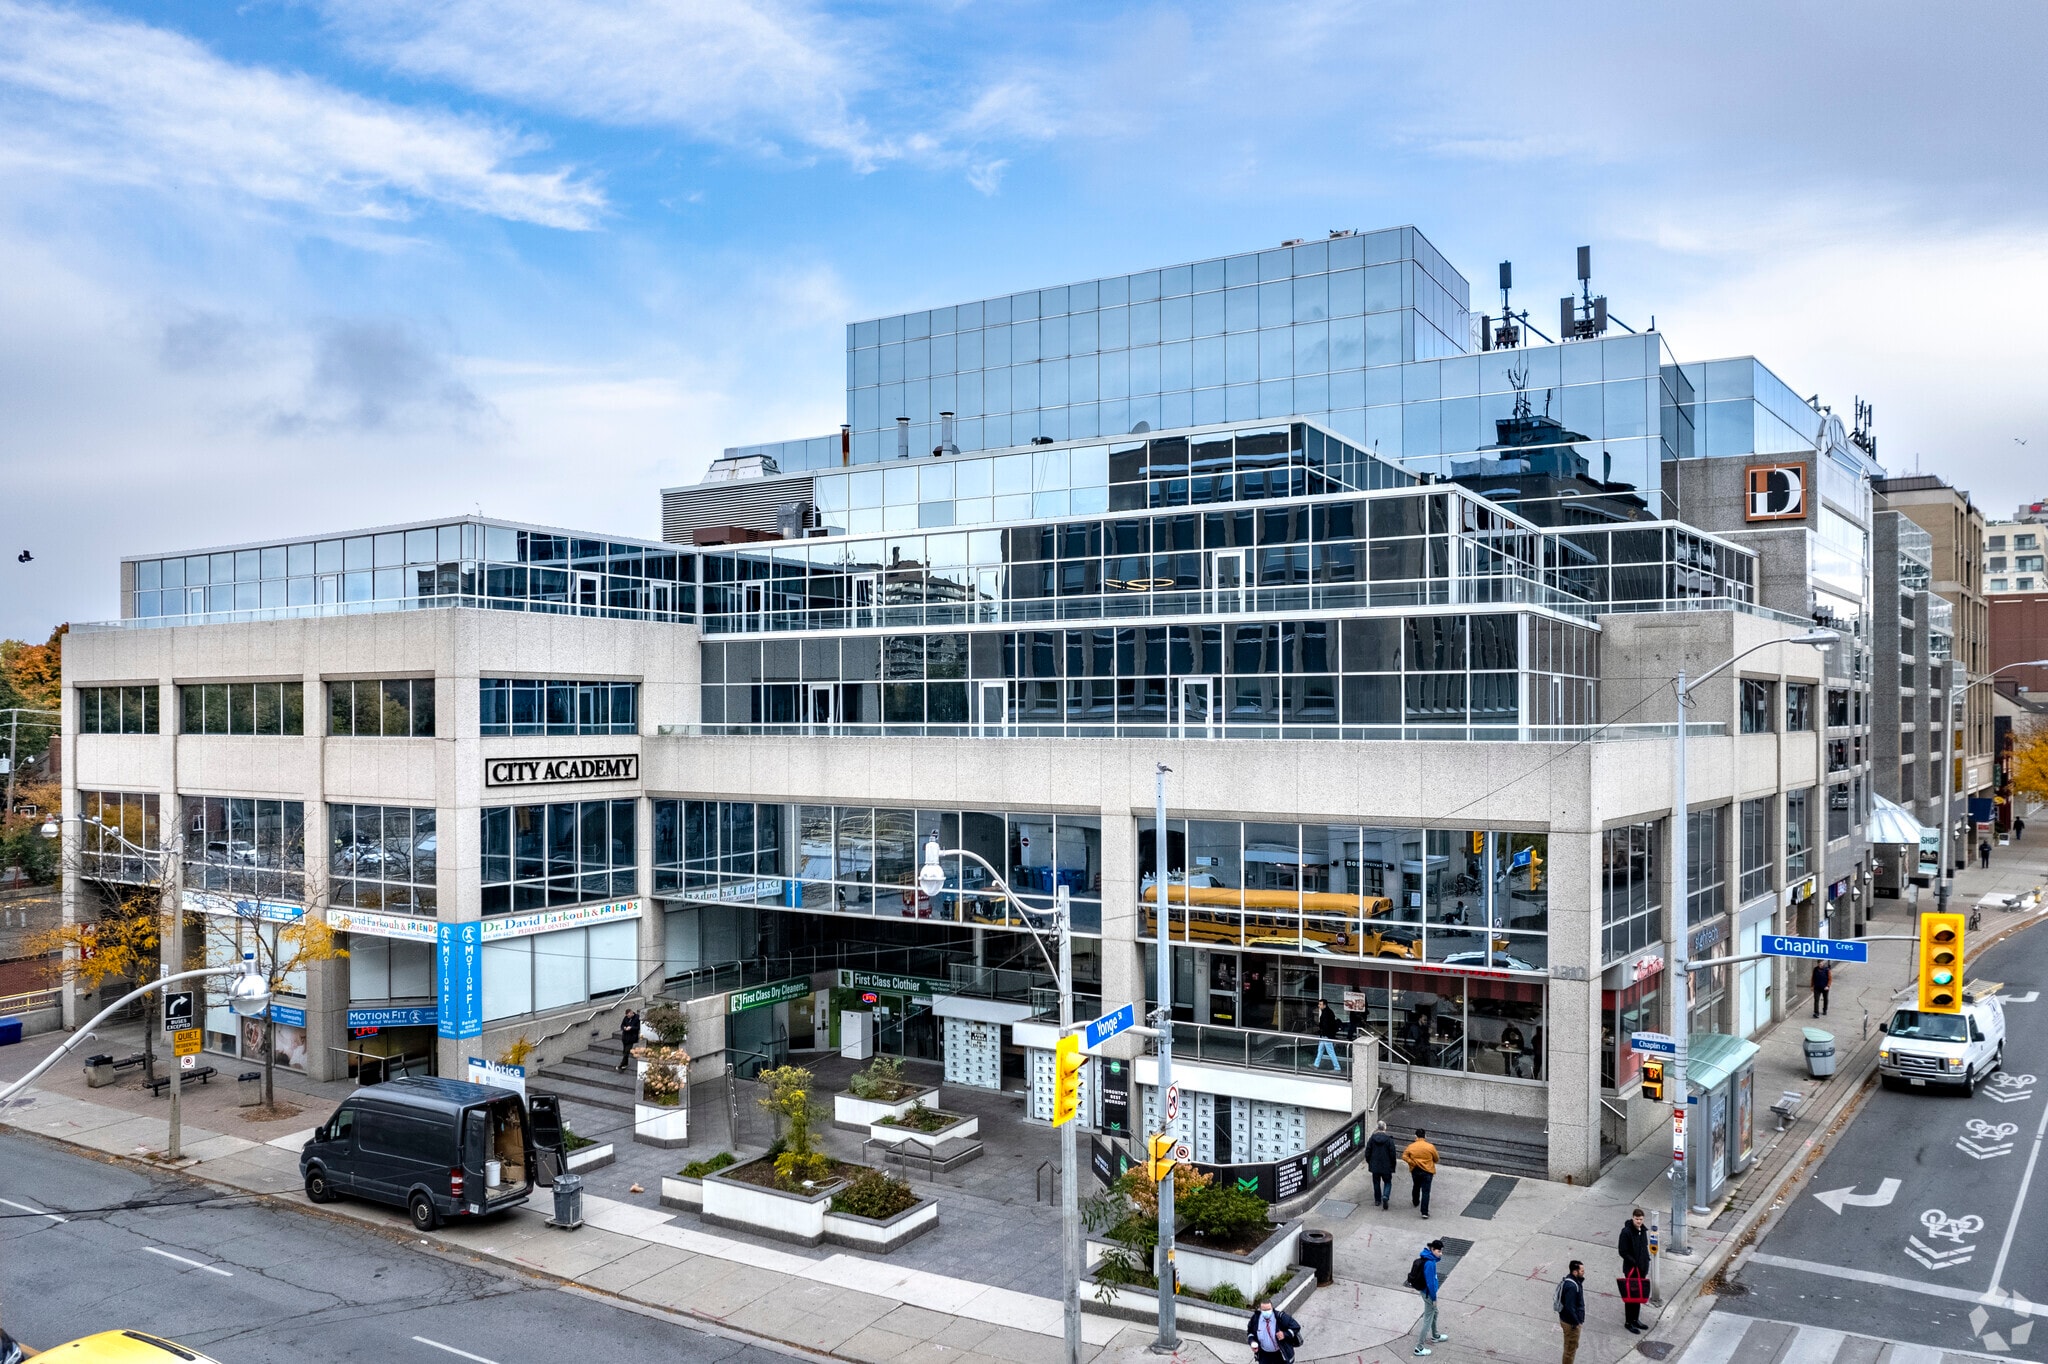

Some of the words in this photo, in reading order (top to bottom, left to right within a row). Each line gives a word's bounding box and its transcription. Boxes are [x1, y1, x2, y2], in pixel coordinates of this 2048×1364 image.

[493, 762, 540, 782] CITY
[543, 758, 633, 780] ACADEMY
[1920, 836, 1939, 845] SHOP
[482, 922, 503, 933] Dr.
[505, 915, 540, 929] David
[544, 908, 590, 924] Farkouh
[591, 909, 599, 917] &
[600, 902, 638, 915] FRIENDS
[367, 915, 399, 929] Farkouh
[400, 922, 407, 931] &
[407, 922, 437, 934] FRIENDS
[518, 923, 546, 935] PEDIATRIC
[548, 921, 571, 931] DENTIST
[1774, 937, 1829, 955] Chaplin
[1835, 942, 1854, 951] Cres
[464, 944, 474, 992] MOTION
[1551, 965, 1586, 980] 1310
[854, 973, 870, 986] First
[871, 975, 891, 988] Class
[892, 977, 920, 992] Clothier
[742, 993, 755, 1004] First
[755, 989, 771, 1001] Class
[771, 987, 781, 998] Dry
[781, 983, 804, 995] Cleaners
[349, 1011, 390, 1021] MOTION
[392, 1010, 407, 1019] FIT
[166, 1022, 191, 1030] EXCEPTED
[1096, 1016, 1118, 1038] Yonge
[177, 1030, 198, 1040] QUIET
[175, 1041, 199, 1049] RESIDENTIAL
[1638, 1040, 1661, 1050] Chaplin
[486, 1060, 520, 1077] Notice
[1103, 1088, 1128, 1096] TORONTO'S
[1105, 1098, 1127, 1106] WORKOUT
[1327, 1133, 1348, 1154] TORONTO'S
[1323, 1153, 1333, 1166] BEST
[1333, 1139, 1351, 1158] WORKOUT
[1279, 1162, 1297, 1171] PERSONAL
[1279, 1167, 1296, 1176] TRAINING
[1288, 1170, 1303, 1178] PRIVATE
[1279, 1182, 1298, 1192] NUTRITION
[1279, 1187, 1298, 1198] RECOVERY
